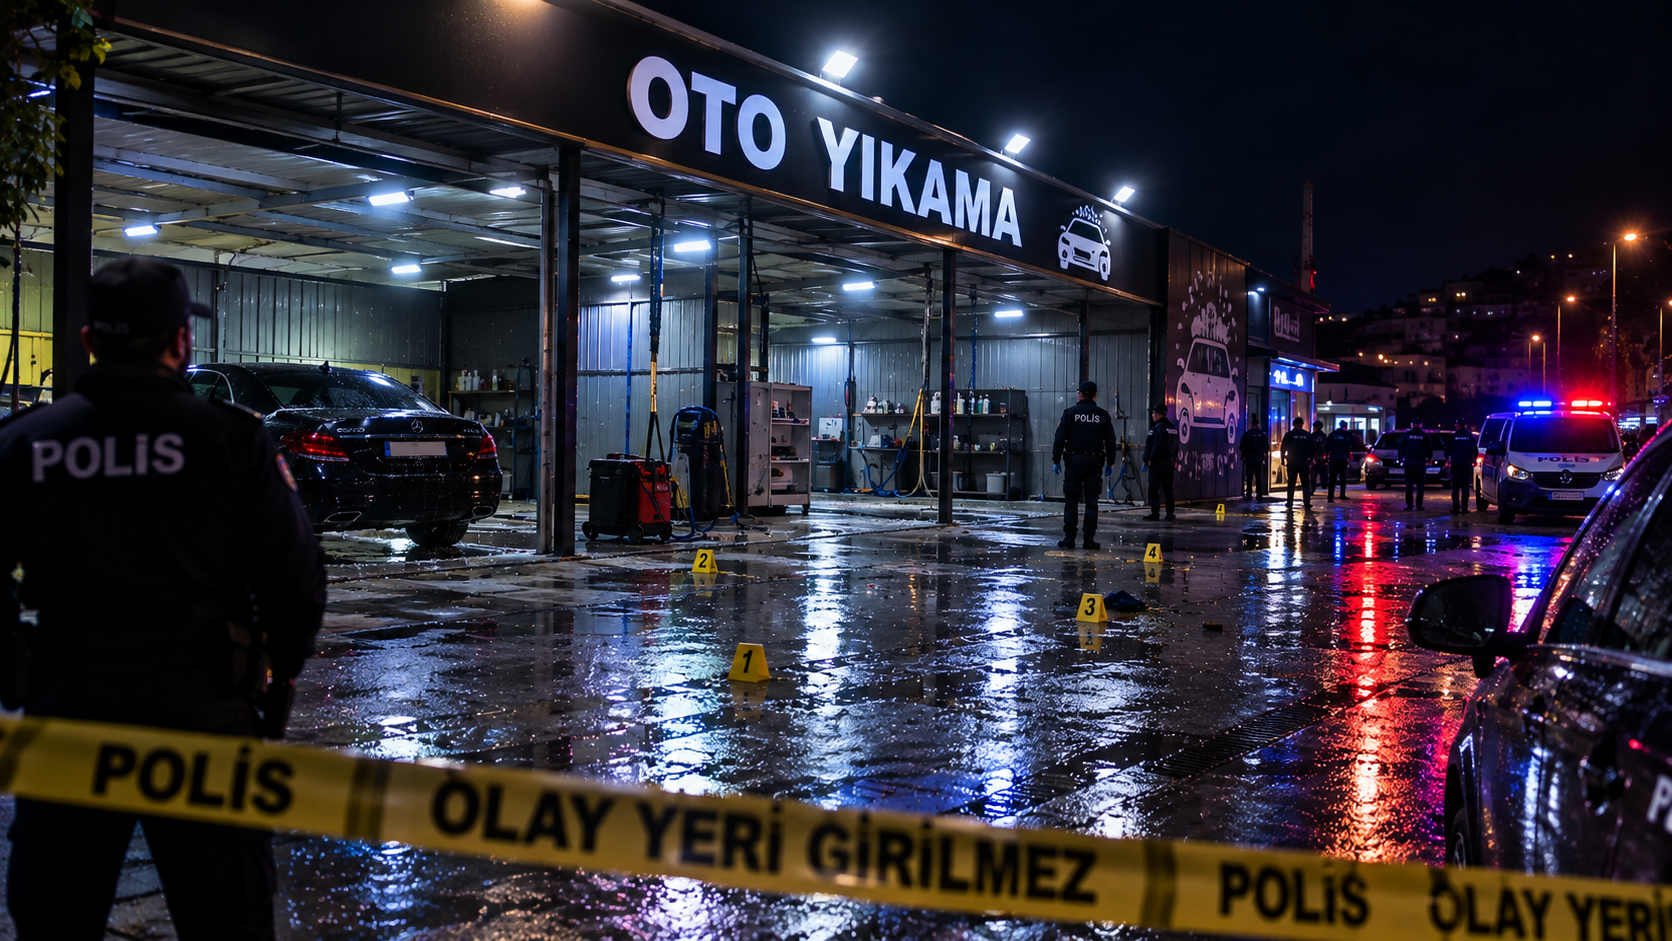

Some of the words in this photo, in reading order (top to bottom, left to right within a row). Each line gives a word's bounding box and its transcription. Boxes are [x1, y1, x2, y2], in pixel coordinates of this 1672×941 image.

[627, 55, 786, 170] OTO
[816, 116, 1022, 248] YIKAMA
[32, 433, 185, 482] POLİS
[698, 553, 708, 568] 2
[1148, 546, 1157, 559] 4
[1084, 597, 1096, 616] 3
[742, 649, 753, 673] 1
[1647, 774, 1672, 834] P
[91, 742, 294, 815] POLİS
[638, 801, 785, 875] YERİ
[806, 812, 1099, 906] GİRİLMEZ
[1218, 861, 1370, 928] POLİS
